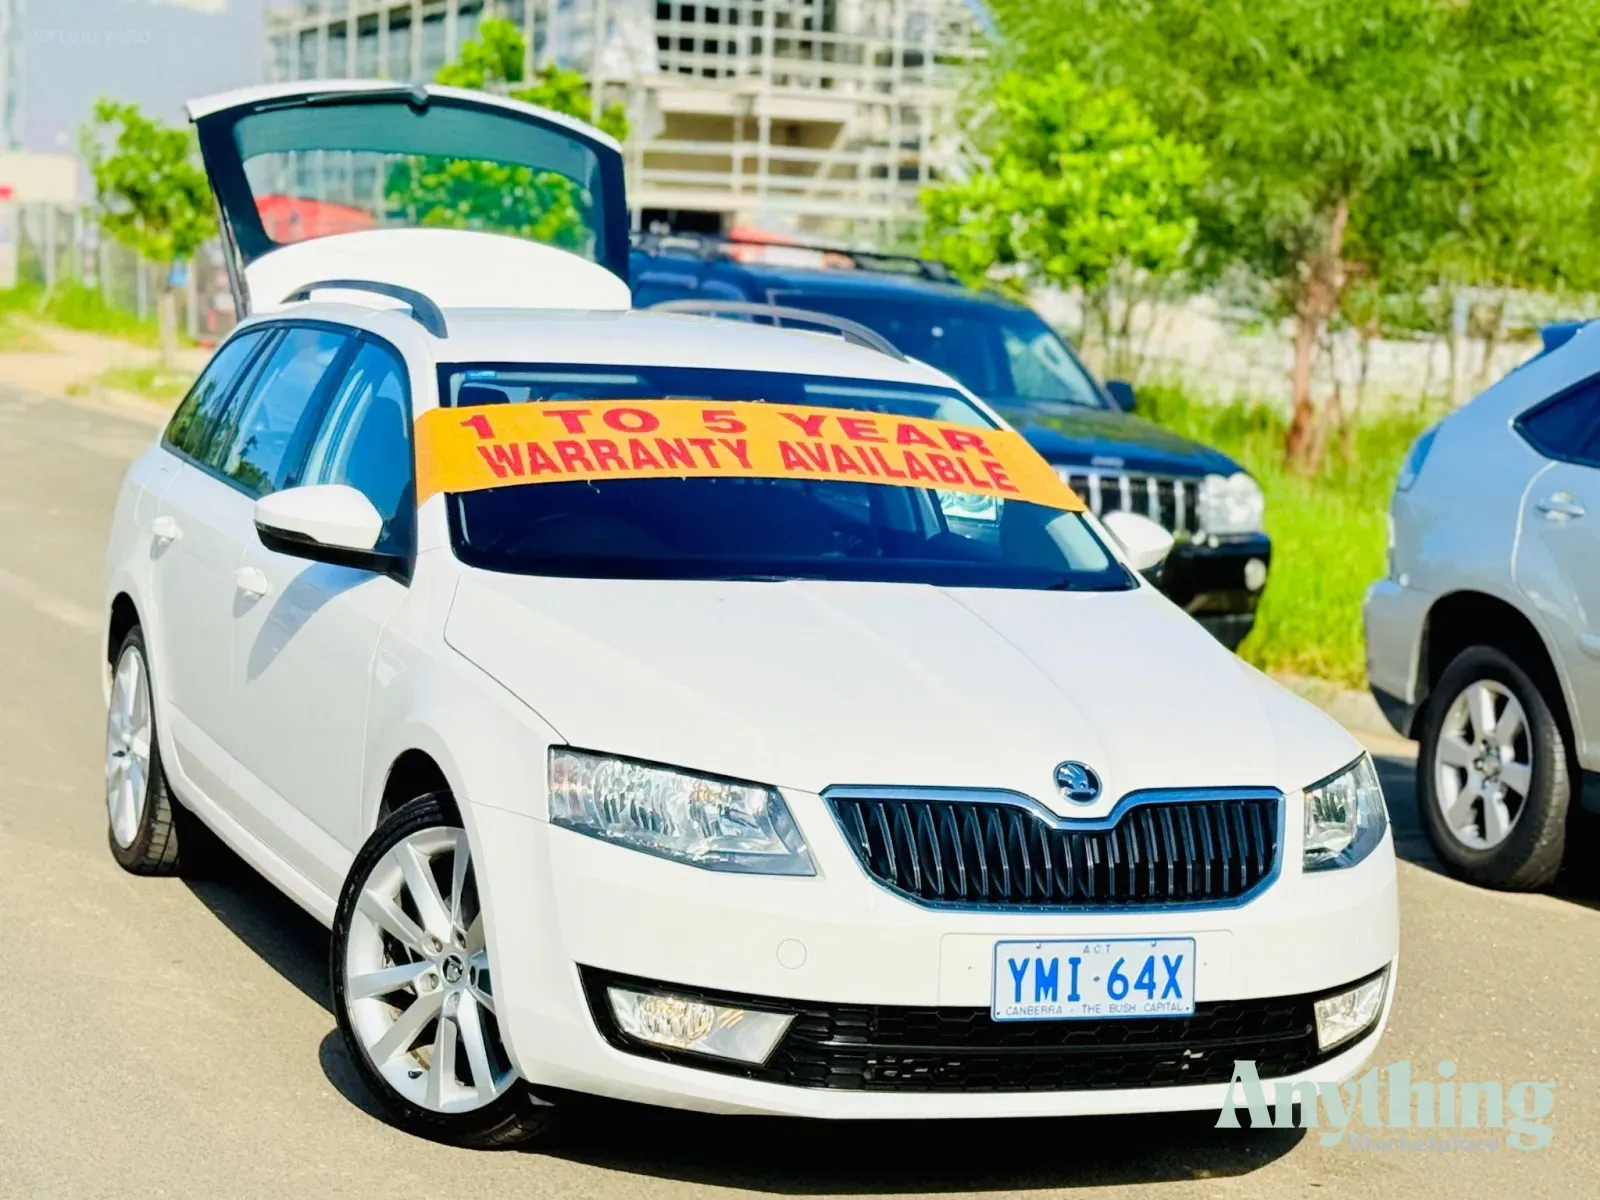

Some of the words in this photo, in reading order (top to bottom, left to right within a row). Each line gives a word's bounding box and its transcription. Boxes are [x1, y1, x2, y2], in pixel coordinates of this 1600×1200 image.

[460, 414, 496, 440] 1
[542, 407, 660, 434] TO
[702, 409, 747, 434] 5
[777, 412, 995, 457] YEAR
[476, 438, 753, 478] WARRANTY
[778, 441, 1020, 493] AVAILABLE
[1083, 944, 1111, 954] ACT
[1005, 1005, 1063, 1016] CANBERRA
[1082, 1004, 1101, 1014] THE
[1109, 1003, 1136, 1014] BUSH
[1144, 1001, 1183, 1013] CAPITAL
